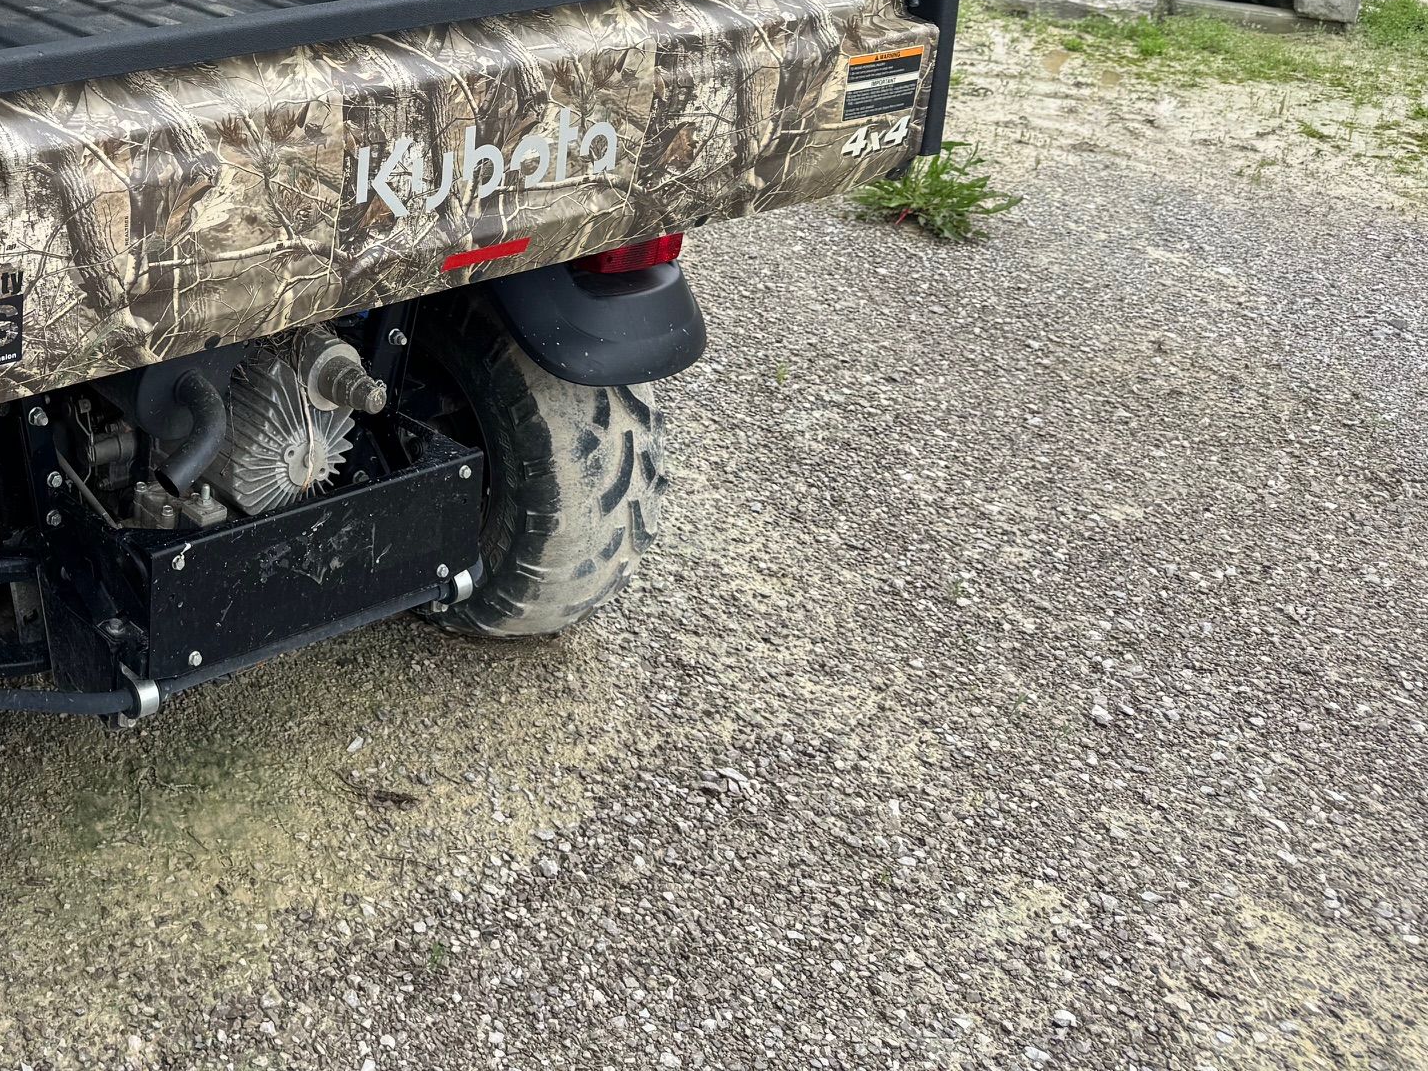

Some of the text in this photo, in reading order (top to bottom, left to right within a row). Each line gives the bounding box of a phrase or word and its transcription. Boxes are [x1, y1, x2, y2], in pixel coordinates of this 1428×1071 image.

[879, 52, 901, 60] WARNING
[871, 77, 897, 87] IMPORTANT
[840, 115, 911, 158] 4x4
[355, 107, 618, 218] Kubota
